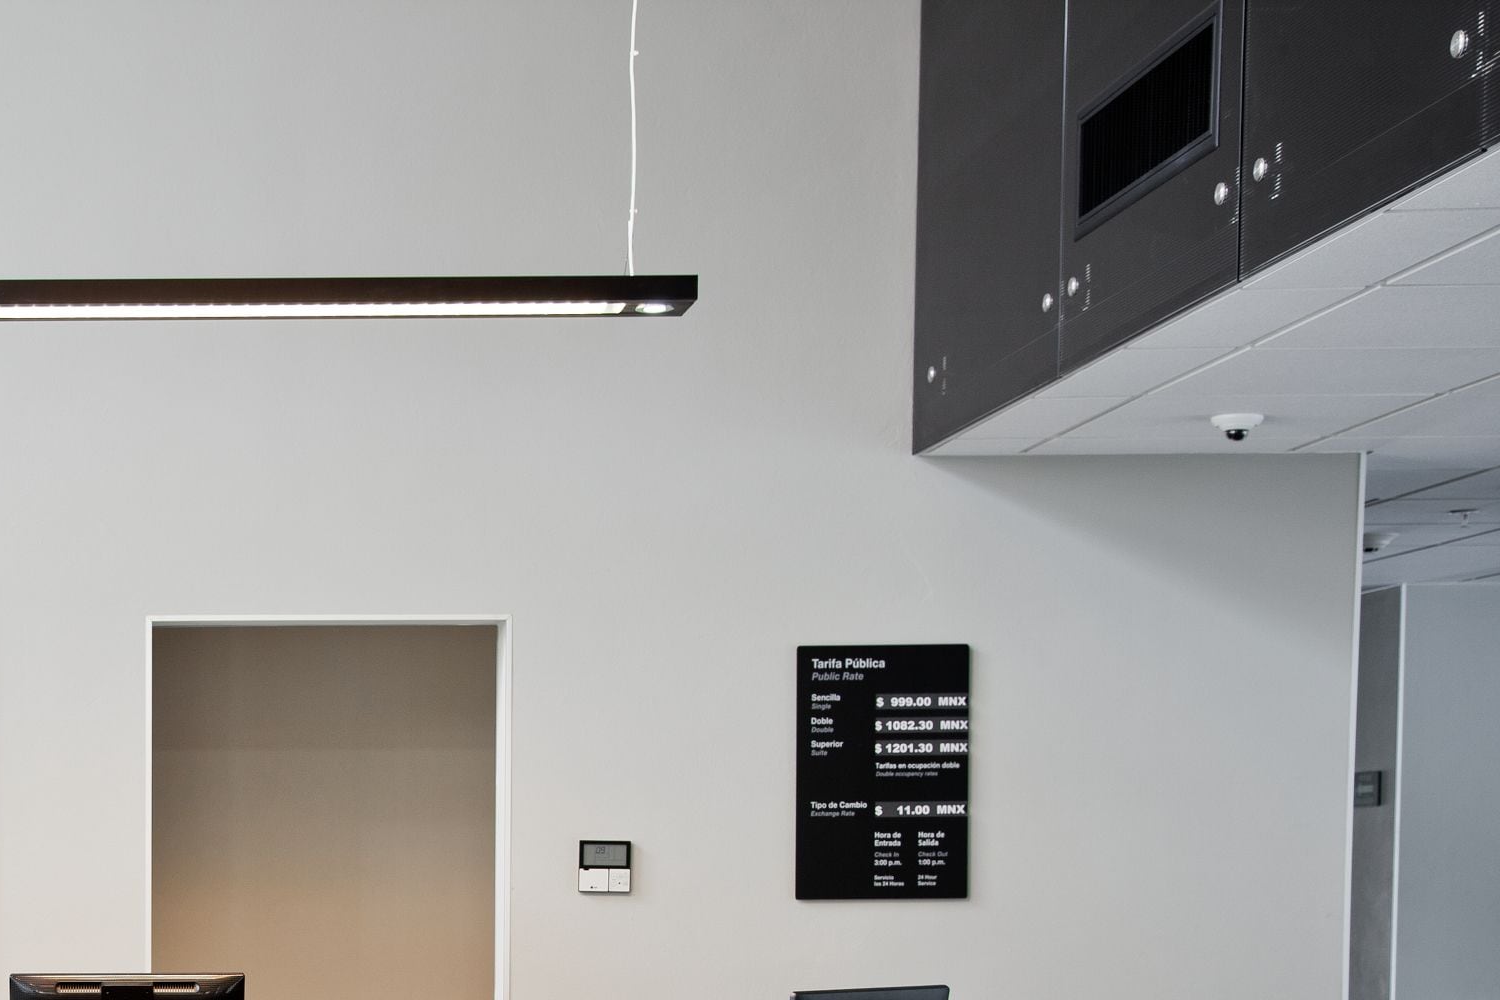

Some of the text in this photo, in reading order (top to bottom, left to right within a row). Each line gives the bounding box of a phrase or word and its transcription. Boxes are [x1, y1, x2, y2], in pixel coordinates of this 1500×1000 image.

[812, 658, 885, 668] Tarifa Pública
[812, 672, 864, 681] Public Rate
[876, 697, 966, 707] $ 999.00 MNX
[811, 717, 833, 725] Doble
[875, 720, 968, 731] $ 1082.30 MNX
[811, 740, 843, 748] Superior
[875, 743, 968, 753] $ 1201.30 MNX
[908, 762, 940, 770] ocupación
[875, 804, 965, 816] $ 11.00 MNX
